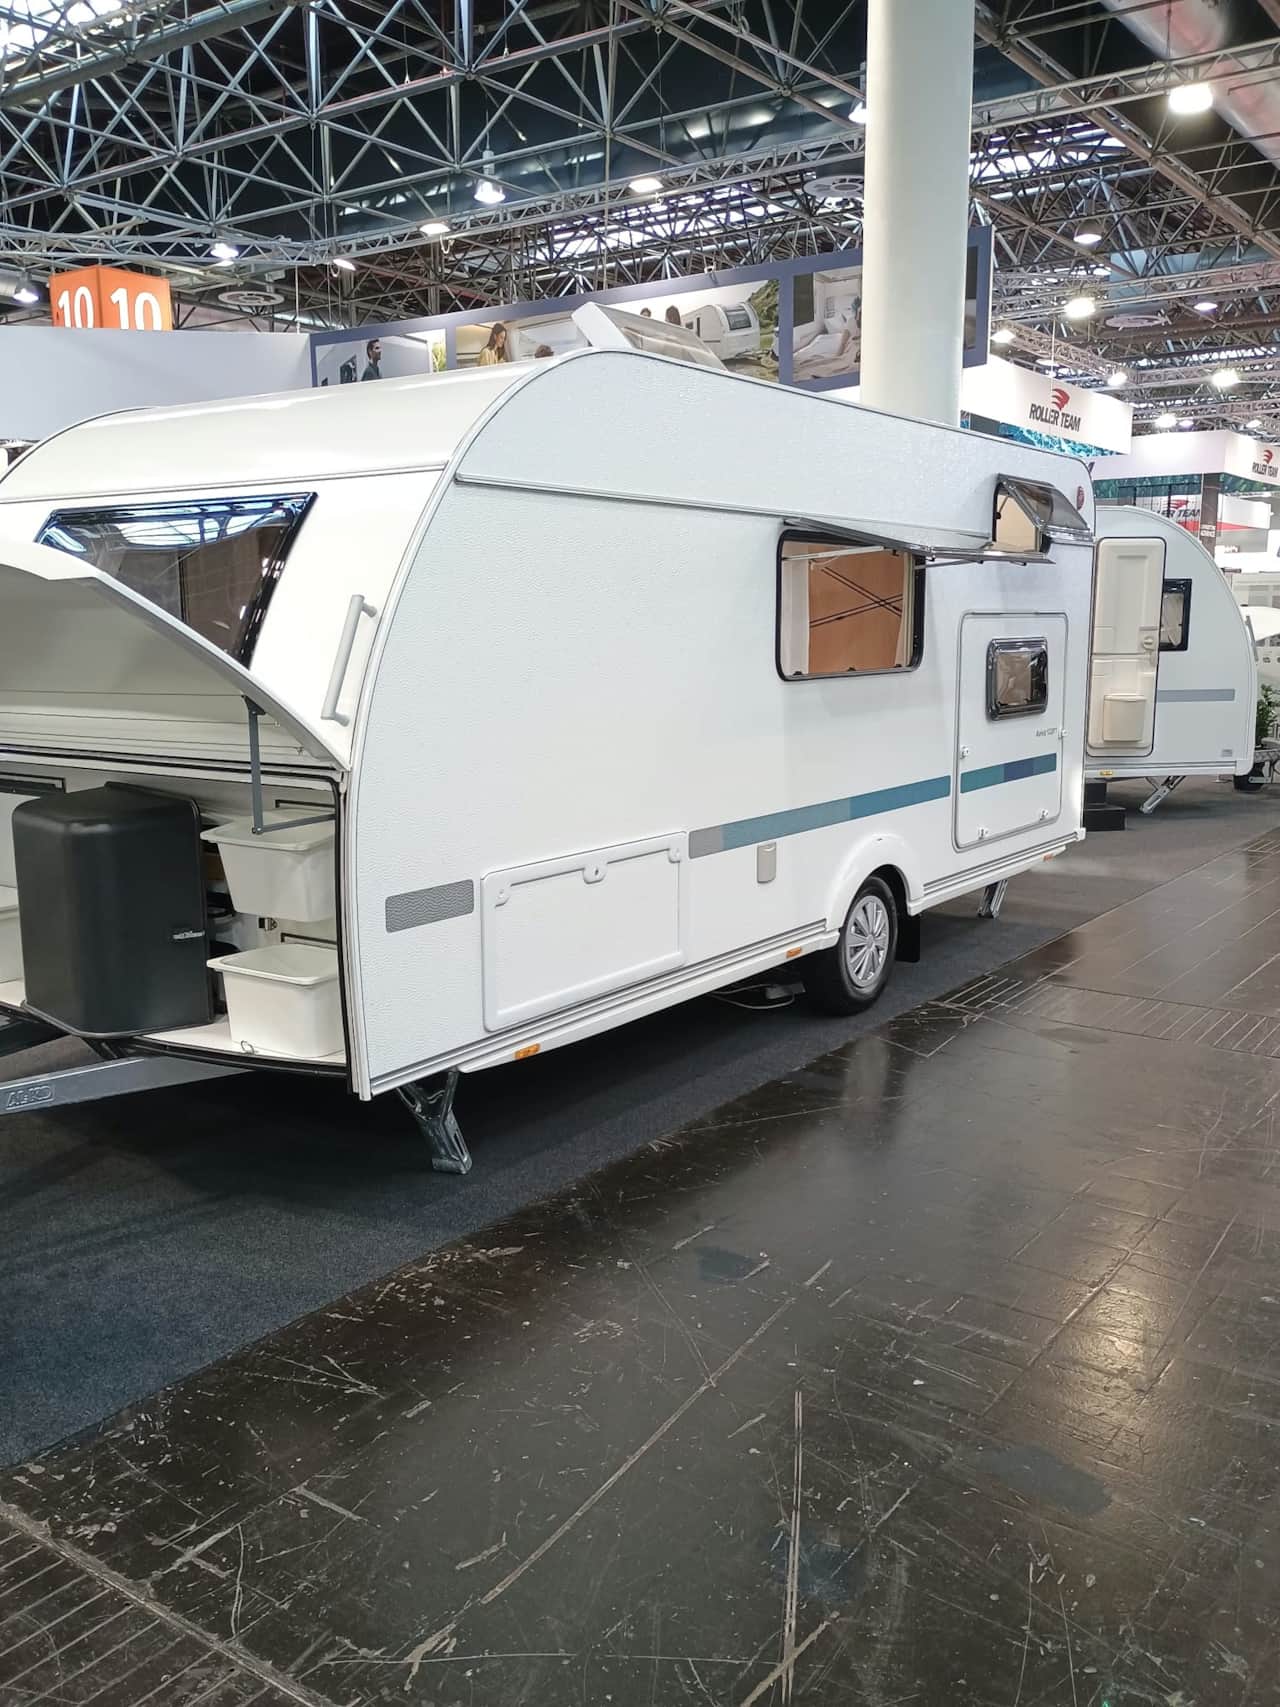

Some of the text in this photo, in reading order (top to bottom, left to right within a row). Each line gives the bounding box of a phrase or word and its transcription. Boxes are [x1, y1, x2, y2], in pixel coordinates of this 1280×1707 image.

[58, 286, 94, 329] 10
[110, 287, 163, 331] 10
[1029, 403, 1081, 432] ROLLER TEAM
